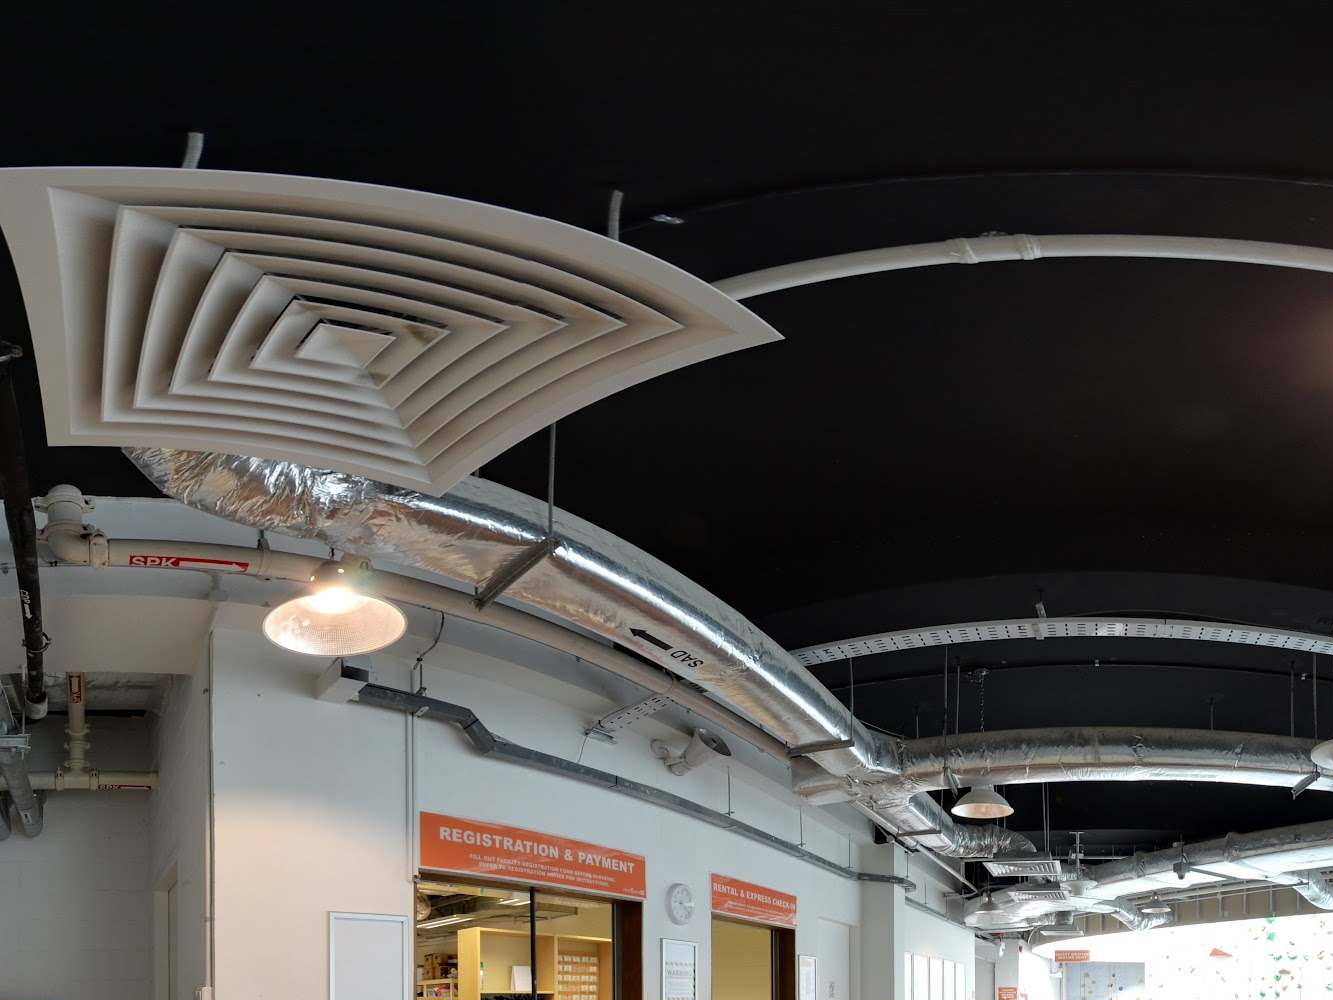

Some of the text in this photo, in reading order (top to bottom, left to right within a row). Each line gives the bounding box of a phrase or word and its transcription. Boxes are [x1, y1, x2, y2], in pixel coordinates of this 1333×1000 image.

[131, 556, 177, 567] SPK
[670, 650, 704, 668] SAD
[440, 826, 634, 873] REGISTRATION & PAYMENT
[479, 861, 498, 869] REFER
[508, 865, 546, 877] REGISTRATION
[497, 857, 520, 866] FACILITY
[522, 861, 559, 872] REGISTRATION
[713, 882, 738, 896] RENTAL
[740, 889, 745, 898] &
[746, 891, 772, 904] EXPRESS
[772, 898, 796, 911] CHECK-IN
